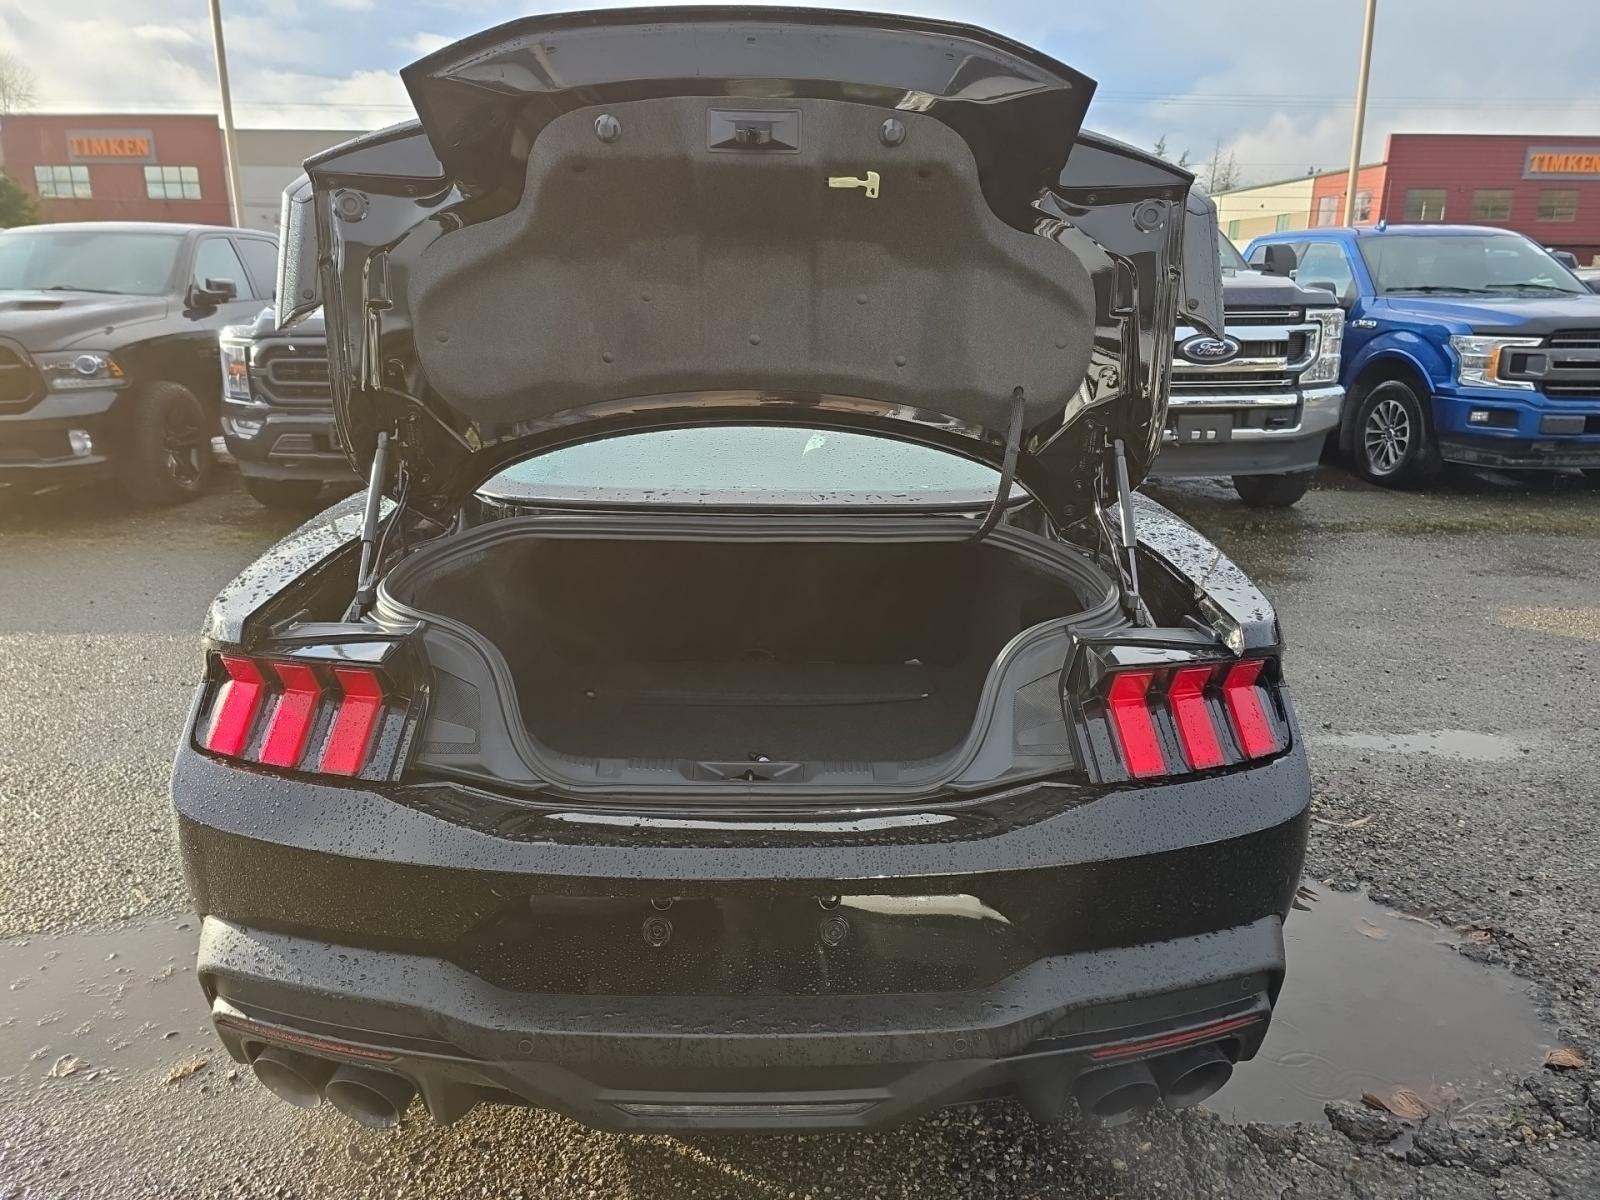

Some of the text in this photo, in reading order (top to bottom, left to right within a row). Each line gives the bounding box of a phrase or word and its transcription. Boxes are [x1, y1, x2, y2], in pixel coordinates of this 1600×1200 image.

[71, 137, 149, 156] TIMKEN
[1529, 152, 1600, 173] TIMKEN
[1197, 341, 1226, 355] Ford
